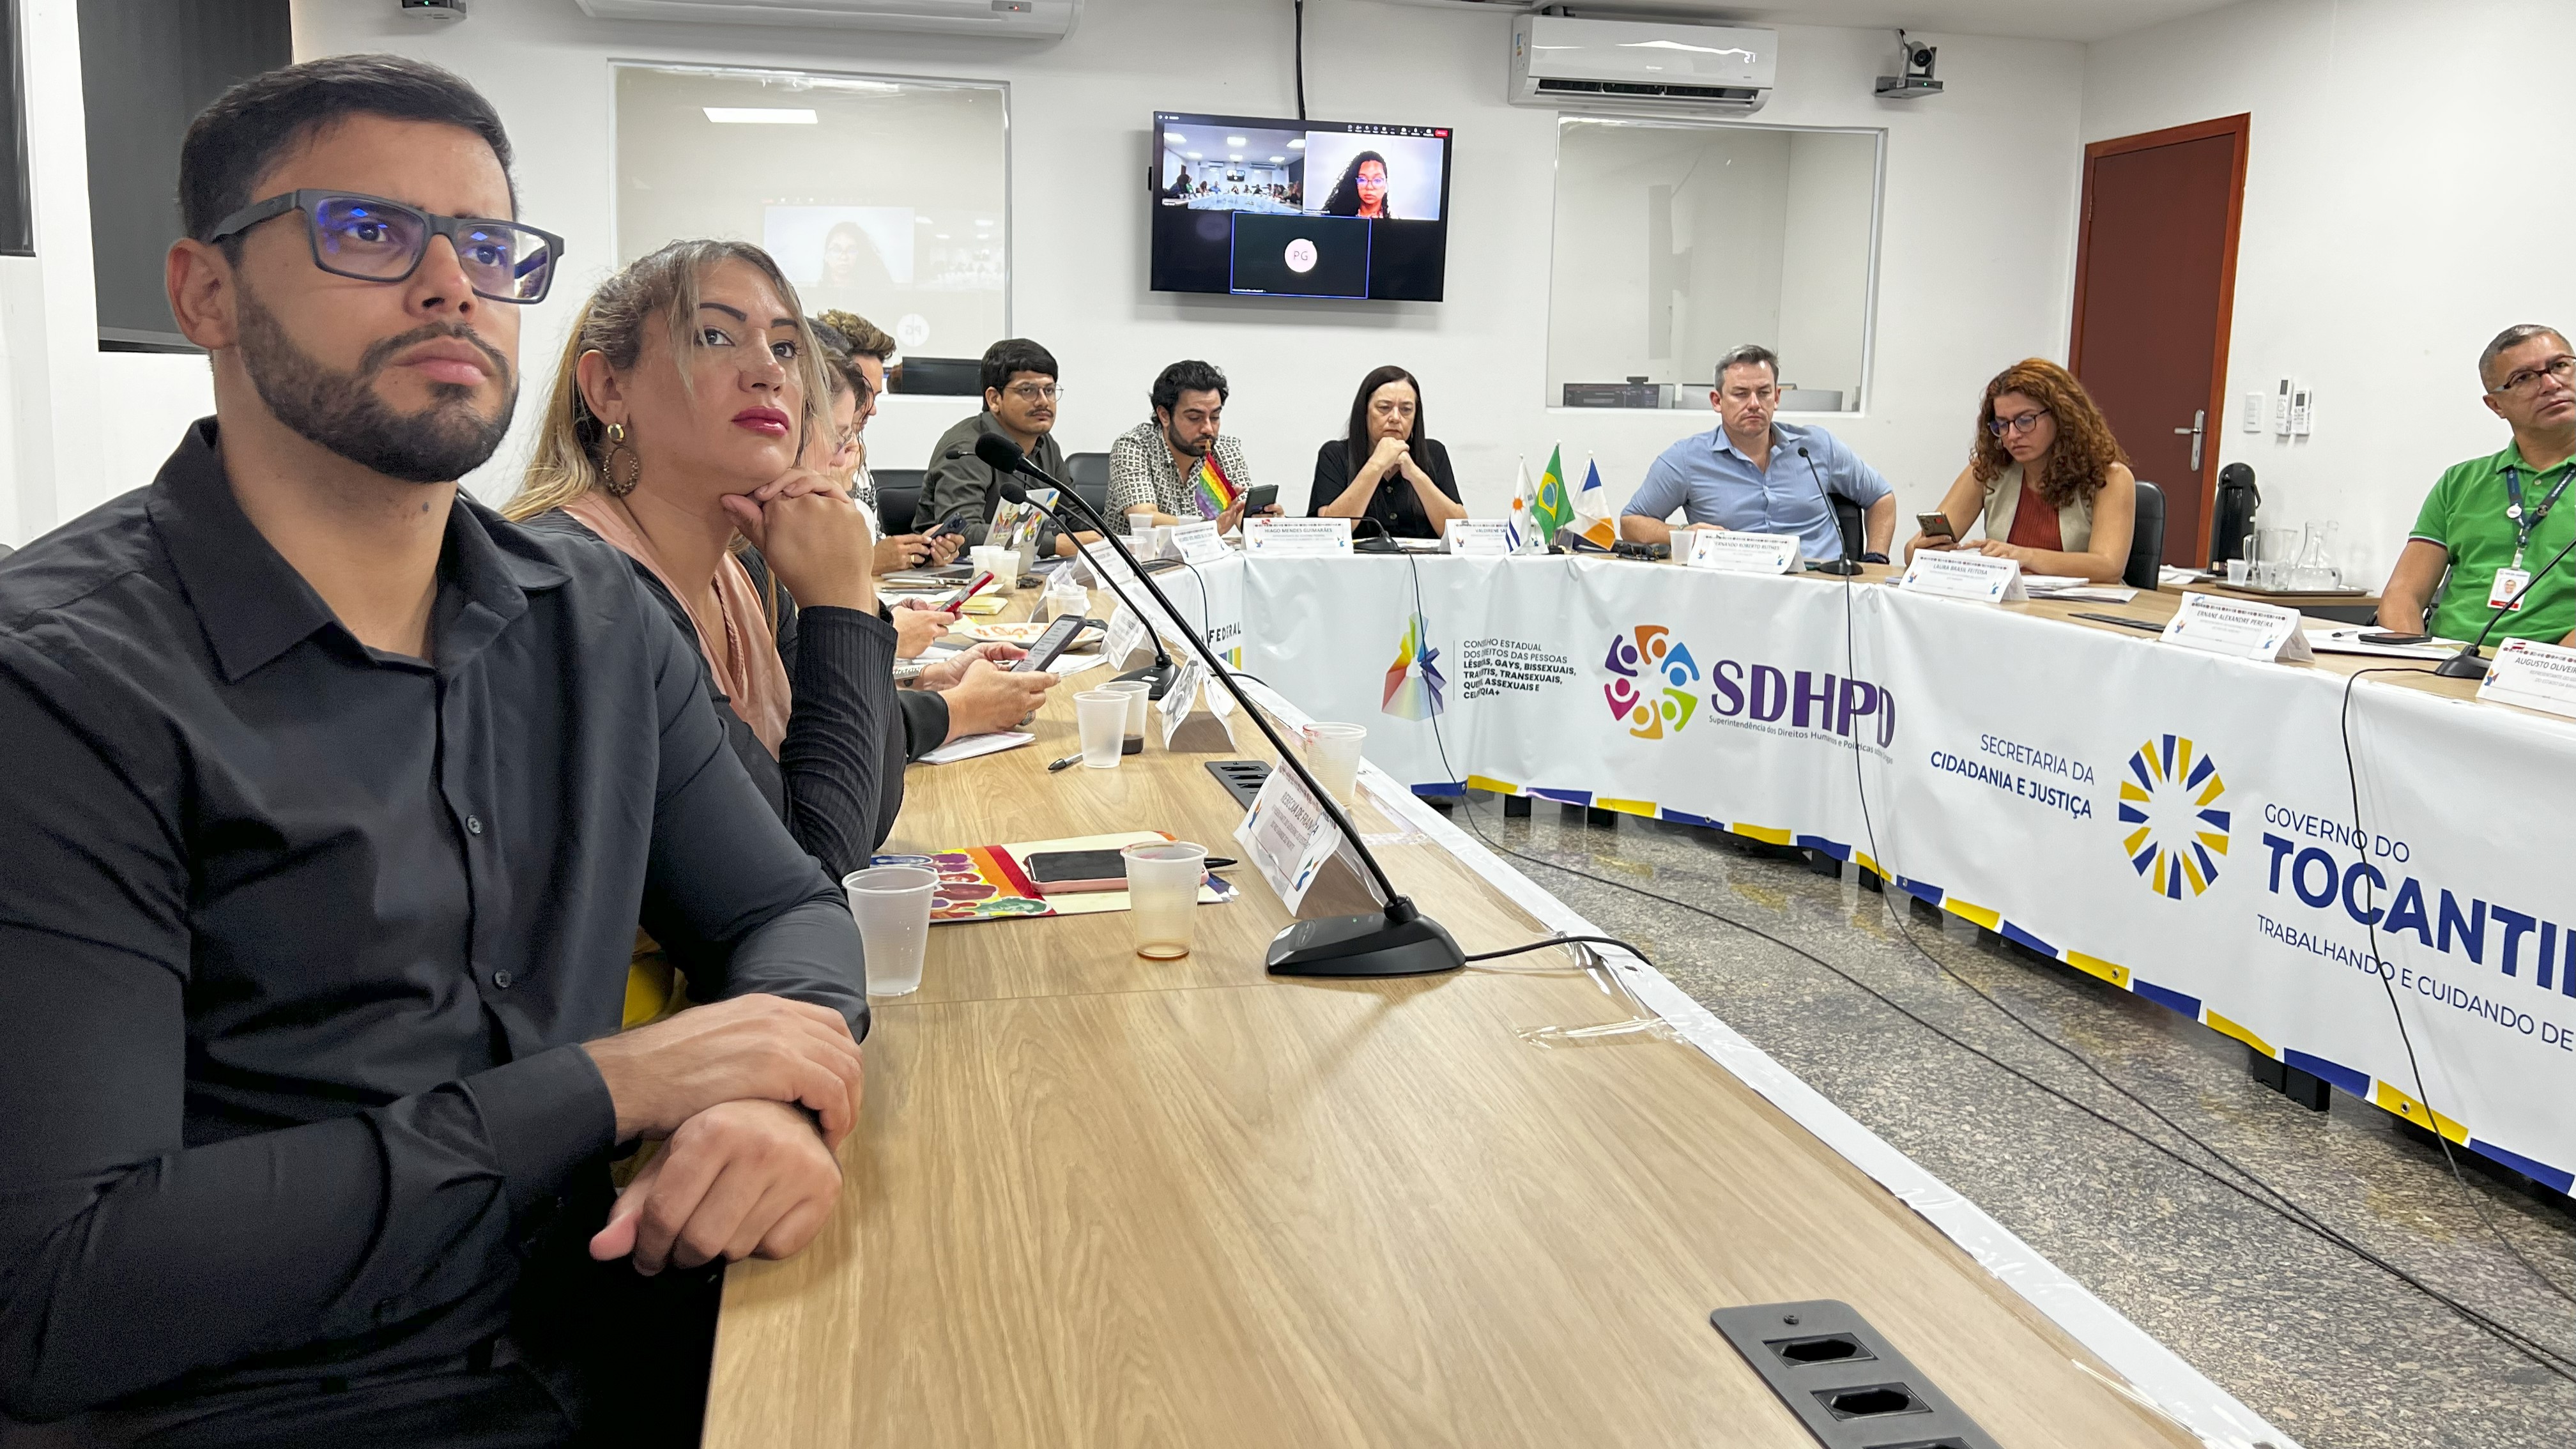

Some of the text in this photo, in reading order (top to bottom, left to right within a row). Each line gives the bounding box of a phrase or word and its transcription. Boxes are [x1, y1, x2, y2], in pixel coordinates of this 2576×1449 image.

[1294, 250, 1308, 261] PG
[2219, 614, 2250, 624] ALEXANDRE
[1209, 622, 1241, 643] FEDERAL
[1500, 640, 1542, 651] ESTADUAL
[1511, 651, 1528, 661] DAS
[1531, 653, 1567, 664] PESSOAS
[2515, 657, 2549, 668] AUGUSTO
[1495, 659, 1522, 671] GAYS,
[1524, 663, 1576, 676] BISSEXUAIS,
[1485, 678, 1536, 691] ASSEXUAIS
[1500, 670, 1562, 684] TRANSEXUAIS,
[1711, 659, 1895, 749] SDHPD
[1709, 715, 1766, 732] Superintendência
[1767, 726, 1777, 735] dos
[1777, 728, 1809, 739] Direitos
[1981, 733, 2094, 785] SECRETARIA DA
[1931, 751, 2092, 819] CIDADANIA E JUSTIÇA
[1295, 807, 1305, 820] DE
[2265, 804, 2410, 862] GOVERNO DO
[2257, 914, 2573, 1052] TRABALHANDO E CUIDANDO DE
